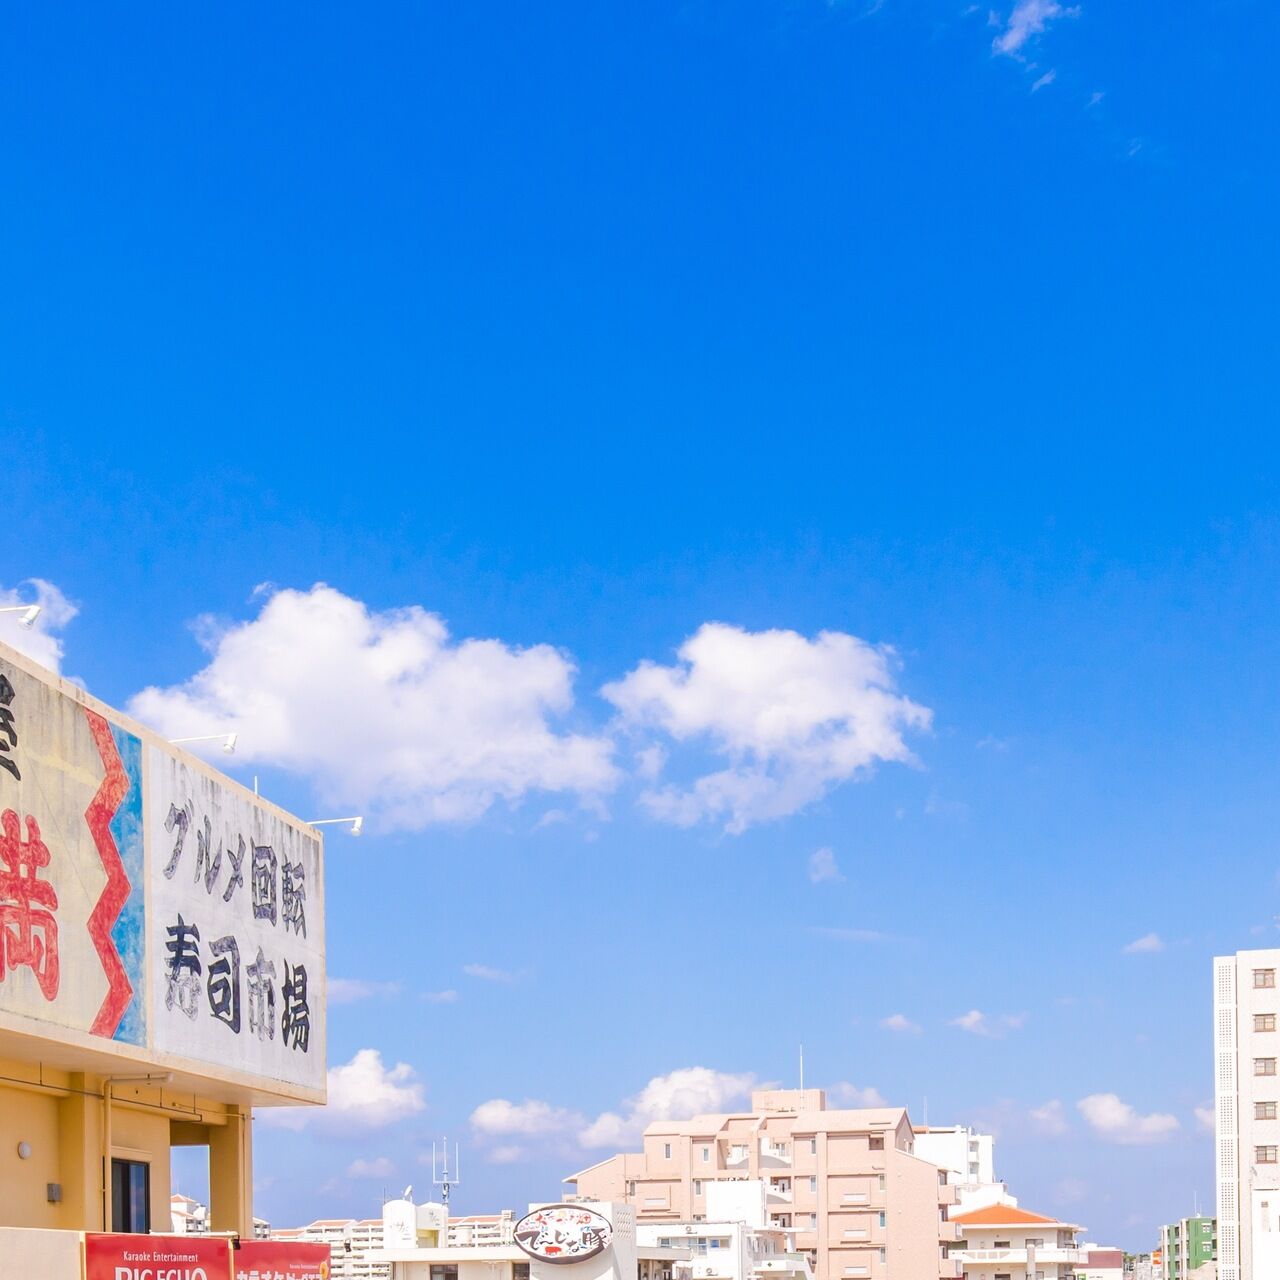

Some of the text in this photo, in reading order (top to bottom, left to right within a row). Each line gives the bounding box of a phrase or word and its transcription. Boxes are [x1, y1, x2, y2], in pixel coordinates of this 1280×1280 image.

[163, 798, 308, 939] グルメ回転
[164, 913, 311, 1053] 寿司市場
[123, 1251, 199, 1263] Karaoke Entertainment
